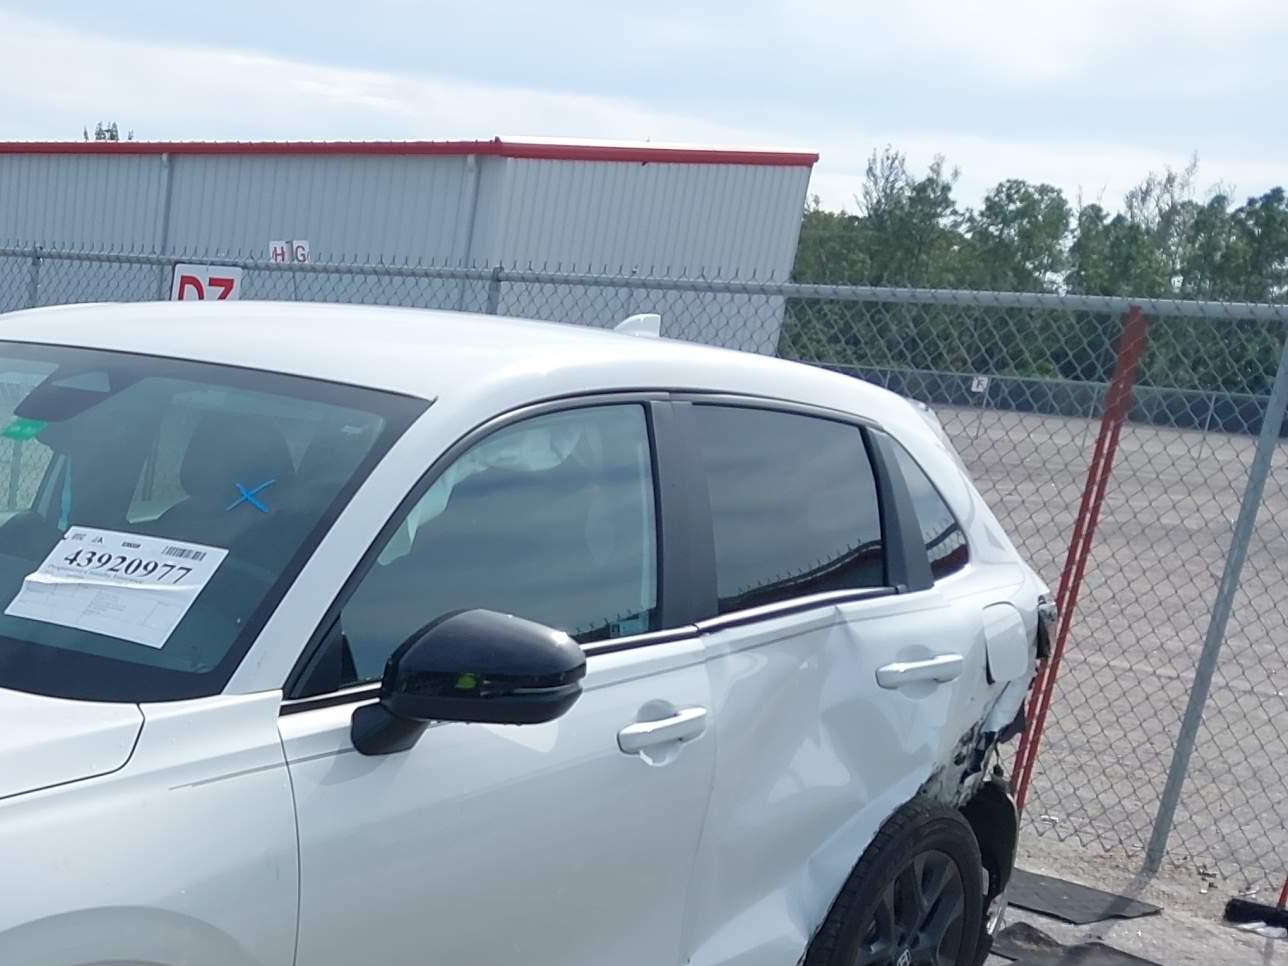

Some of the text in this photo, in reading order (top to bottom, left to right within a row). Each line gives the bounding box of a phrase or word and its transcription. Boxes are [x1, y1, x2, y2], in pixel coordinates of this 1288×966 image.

[273, 246, 286, 263] H
[295, 245, 307, 263] G
[64, 547, 193, 585] 43920977
